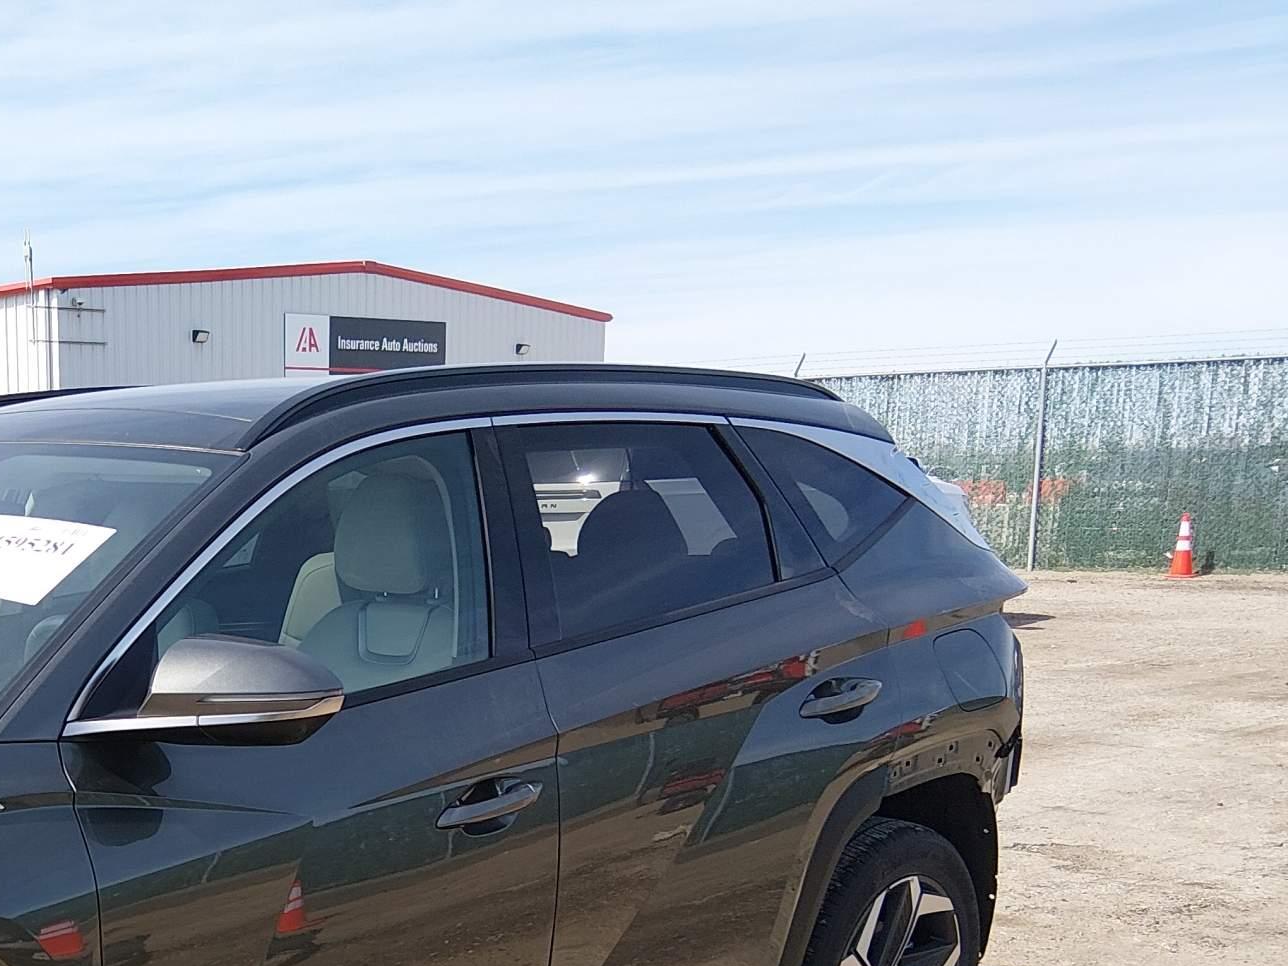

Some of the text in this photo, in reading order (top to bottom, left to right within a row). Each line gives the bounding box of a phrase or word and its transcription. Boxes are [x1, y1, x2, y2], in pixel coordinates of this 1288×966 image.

[337, 335, 438, 353] Insurance Auto Auctions
